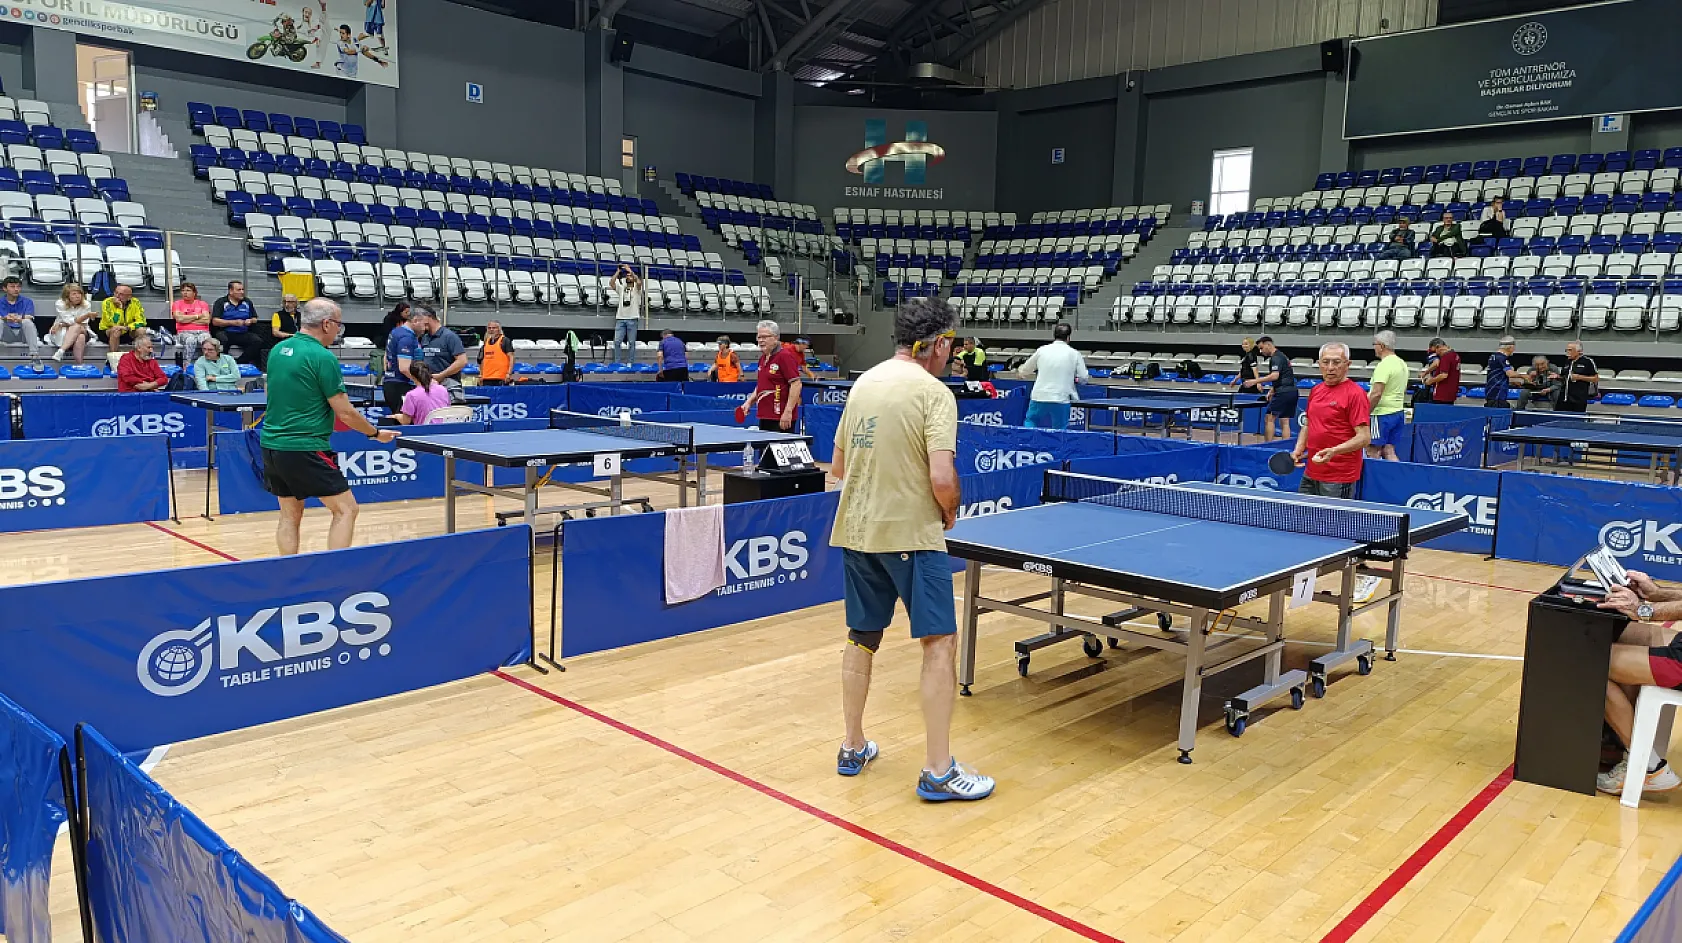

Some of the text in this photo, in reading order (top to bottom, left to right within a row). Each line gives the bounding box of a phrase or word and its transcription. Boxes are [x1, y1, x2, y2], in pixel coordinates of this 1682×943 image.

[12, 0, 73, 12] OR
[103, 6, 239, 40] MÜDÜRLÜĞÜ
[1478, 79, 1490, 88] VE
[845, 186, 880, 198] ESNAF
[483, 402, 528, 419] KBS
[975, 411, 1003, 427] KBS
[1070, 407, 1084, 421] BS
[119, 412, 184, 434] KBS
[338, 448, 417, 477] KBS
[603, 457, 612, 470] 6
[0, 465, 66, 500] BS
[0, 501, 24, 510] NNIS
[1469, 526, 1495, 536] TENN
[724, 530, 809, 580] KBS
[1642, 553, 1675, 565] TABLE
[716, 577, 775, 597] TABLE TENNIS
[1300, 577, 1309, 599] 7
[218, 591, 393, 671] KBS
[220, 656, 332, 688] TABLE TENNIS
